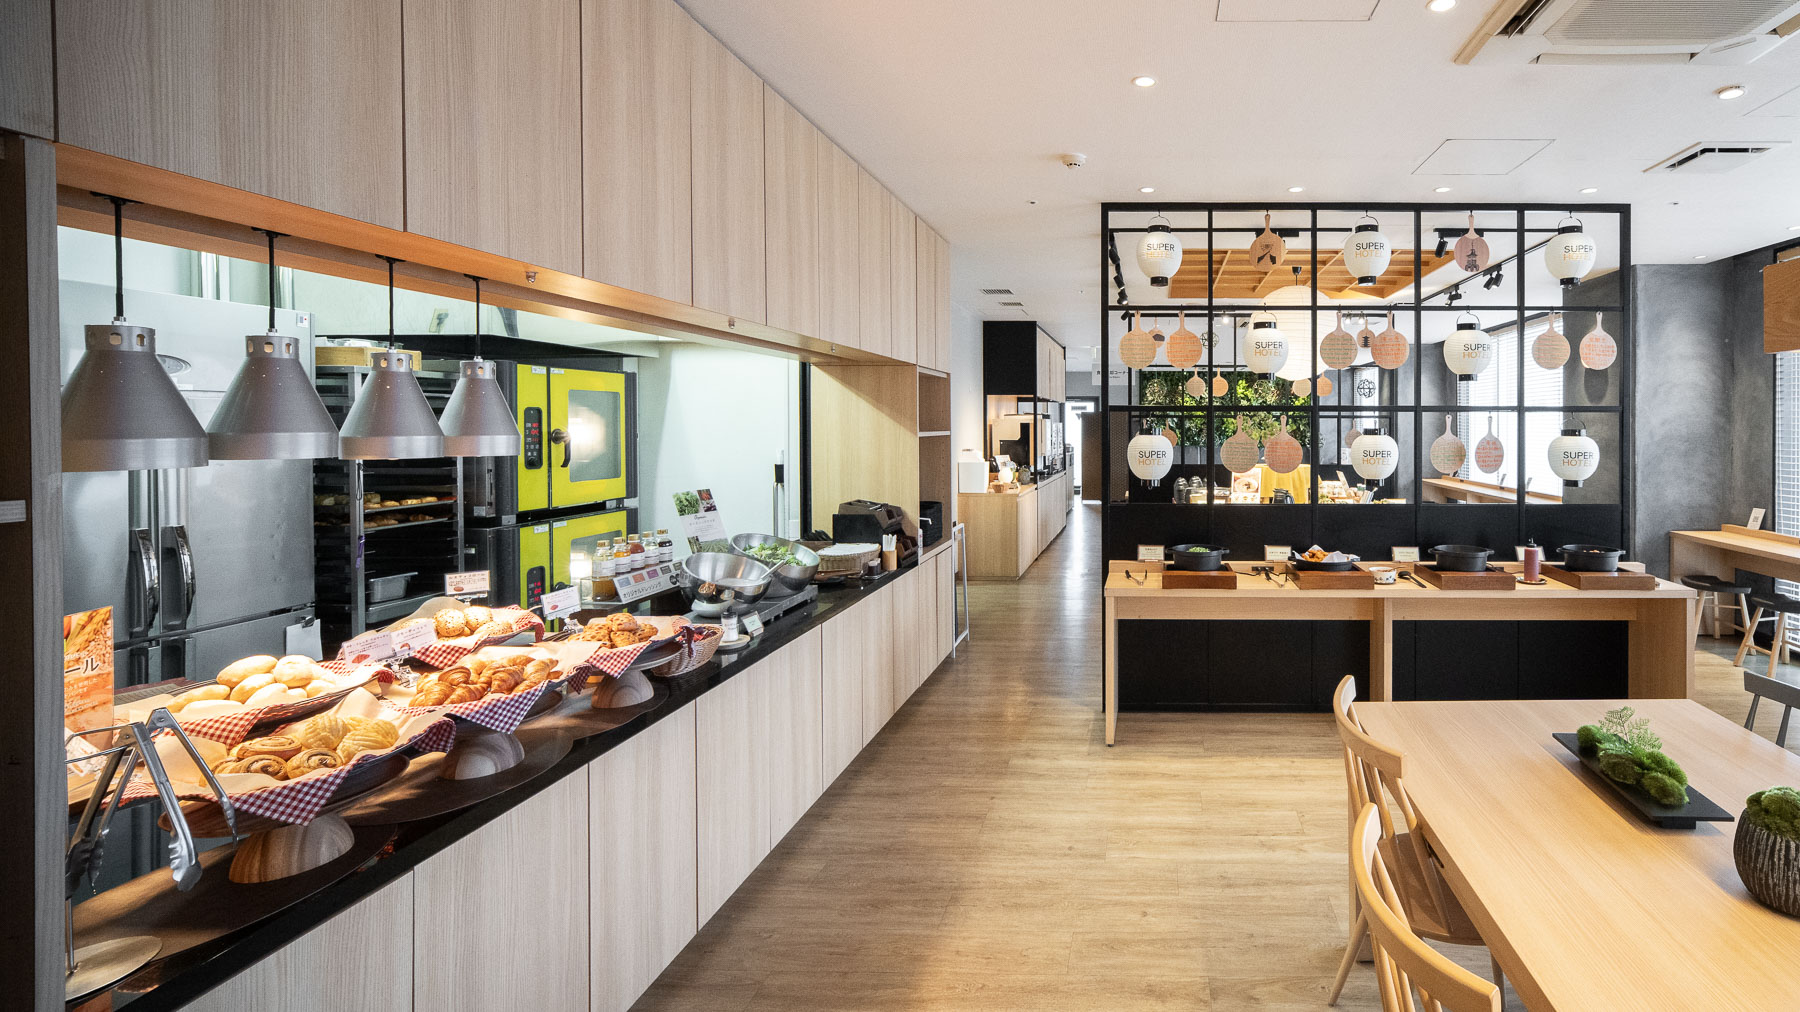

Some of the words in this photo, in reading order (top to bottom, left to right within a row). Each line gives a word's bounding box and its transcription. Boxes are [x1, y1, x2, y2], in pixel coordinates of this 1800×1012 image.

[1146, 243, 1175, 252] SUPER
[1355, 241, 1385, 250] SUPER
[1563, 245, 1594, 254] SUPER
[1354, 249, 1384, 258] HOTEL
[1254, 341, 1283, 349] SUPER
[1463, 343, 1491, 352] SUPER
[1254, 349, 1283, 357] HOTEL
[1138, 450, 1167, 459] SUPER
[1362, 450, 1392, 458] SUPER
[1562, 451, 1594, 460] SUPER
[1137, 458, 1166, 466] HOTEL
[1361, 457, 1391, 466] HOTEL
[1562, 458, 1593, 467] HOTEL
